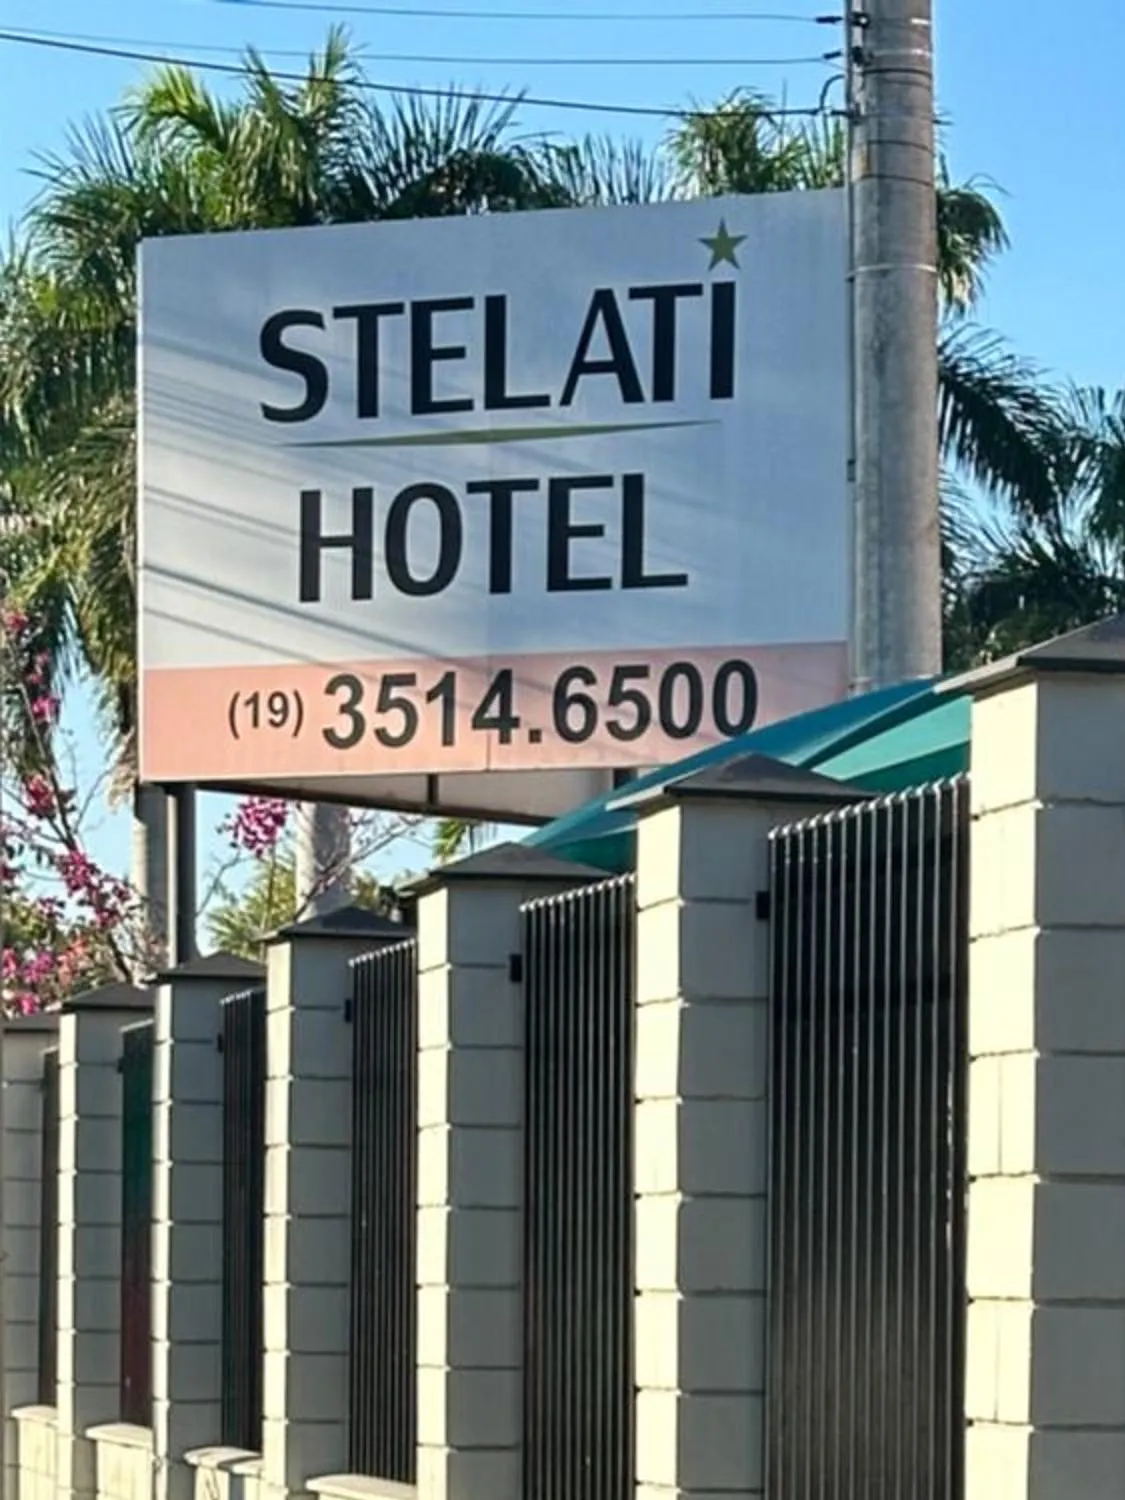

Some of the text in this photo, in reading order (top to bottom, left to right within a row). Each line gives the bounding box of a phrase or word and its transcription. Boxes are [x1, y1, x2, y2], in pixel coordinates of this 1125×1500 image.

[259, 281, 737, 424] STELATI
[299, 473, 689, 603] HOTEL
[228, 659, 759, 750] (19) 3514.6500
